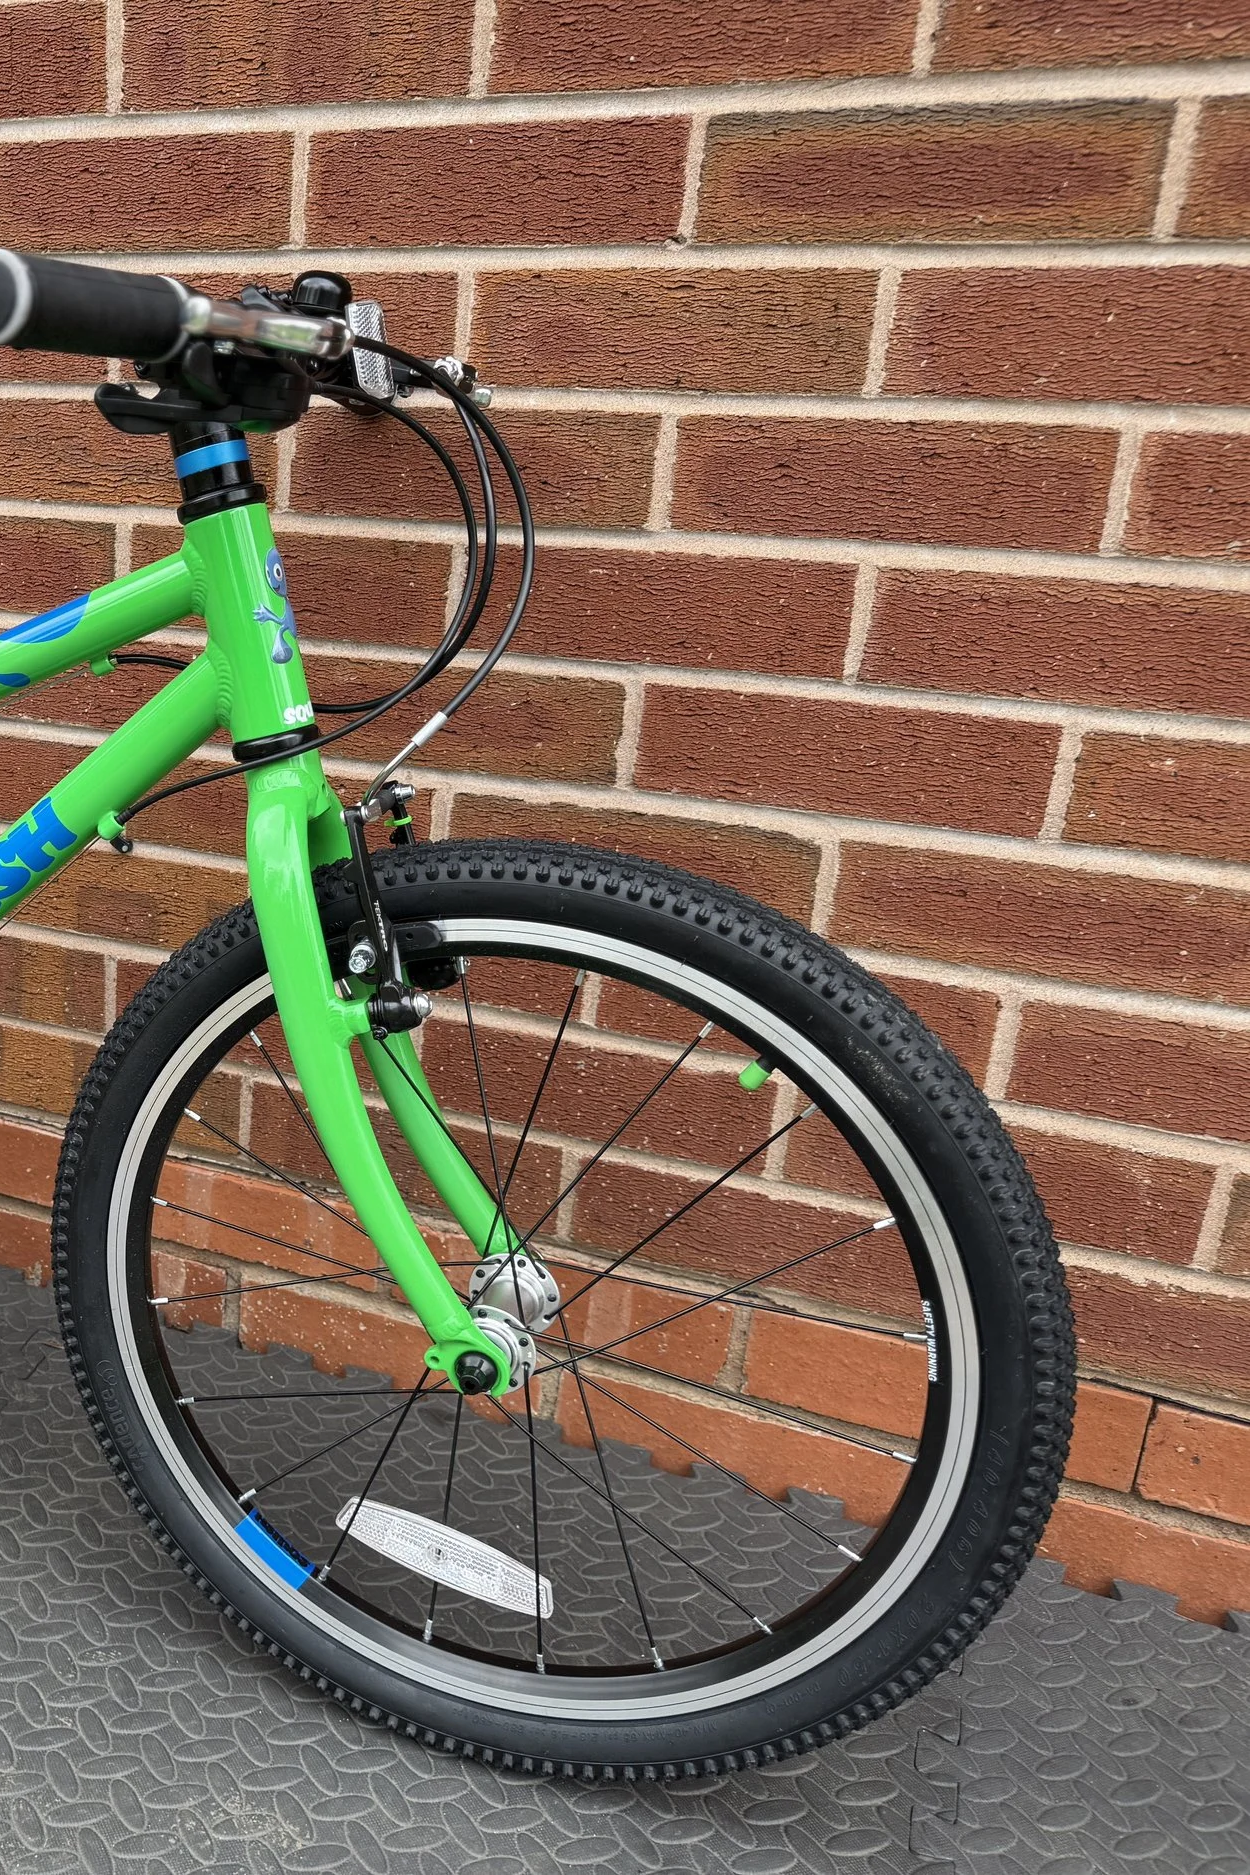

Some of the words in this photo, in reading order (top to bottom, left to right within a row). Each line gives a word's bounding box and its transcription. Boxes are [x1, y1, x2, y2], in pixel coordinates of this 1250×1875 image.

[372, 899, 390, 952] TEKTRO
[921, 1300, 936, 1338] SAFETY
[927, 1336, 938, 1383] WARNING
